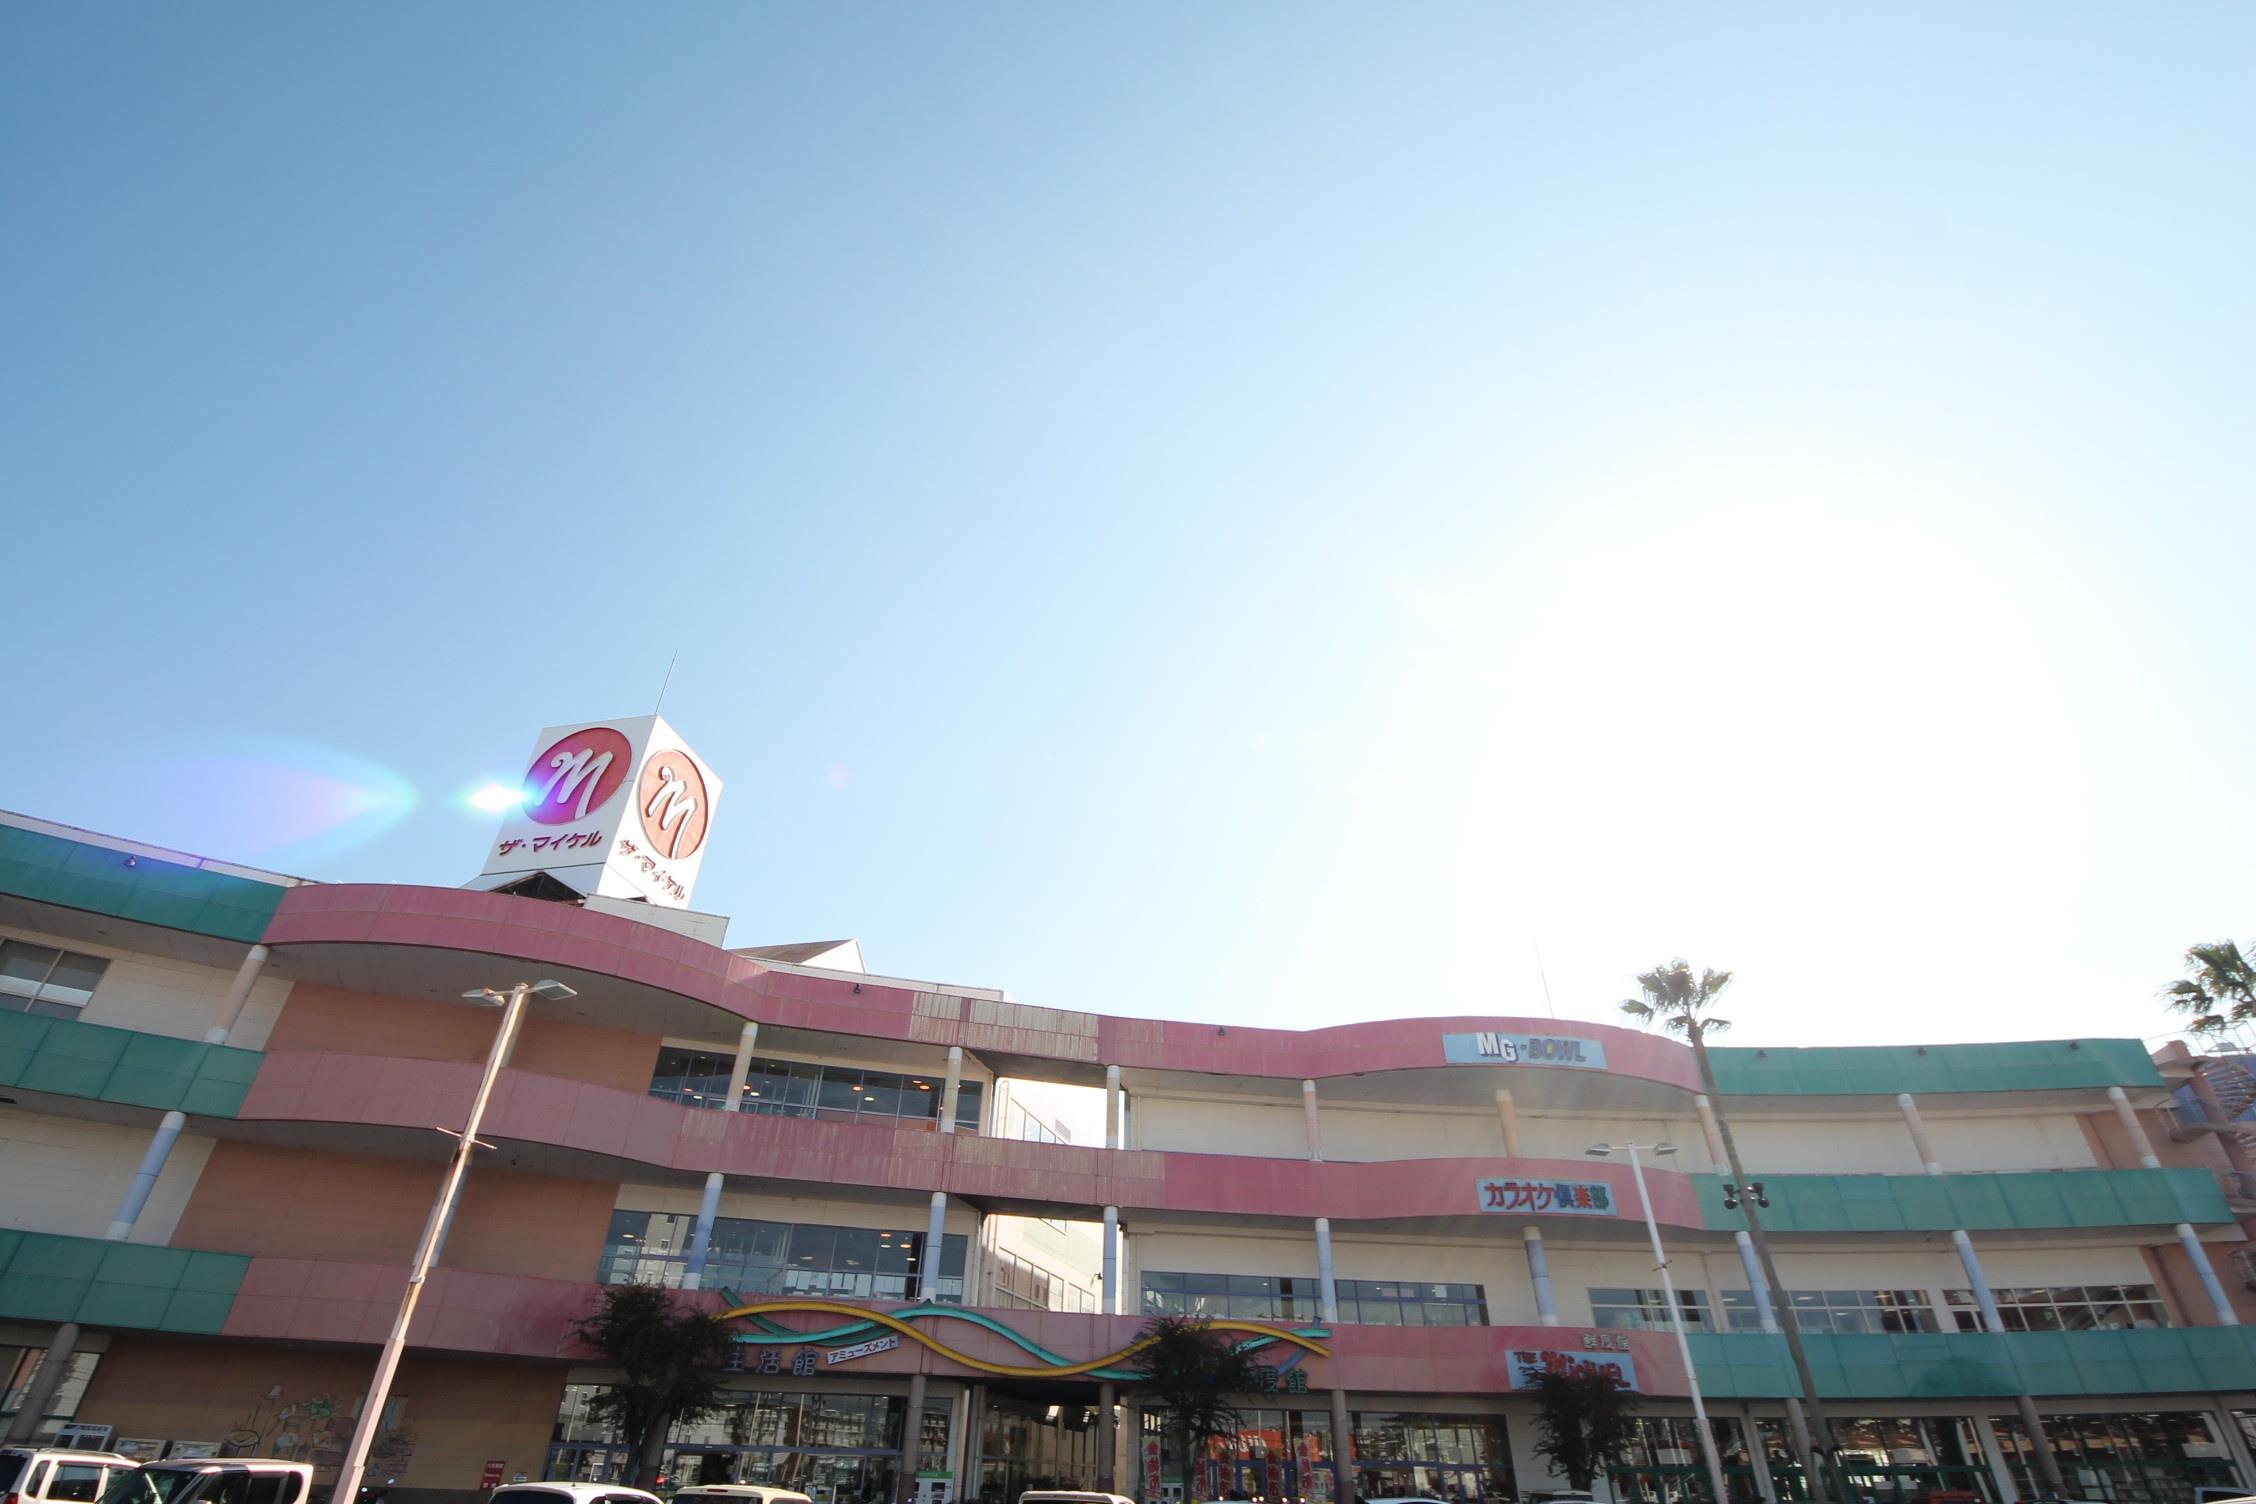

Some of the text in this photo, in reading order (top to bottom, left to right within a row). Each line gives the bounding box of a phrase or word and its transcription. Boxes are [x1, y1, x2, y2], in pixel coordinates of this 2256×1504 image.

[1484, 1181, 1609, 1212] カラオケ倶楽部
[829, 1337, 898, 1362] アミューズメント
